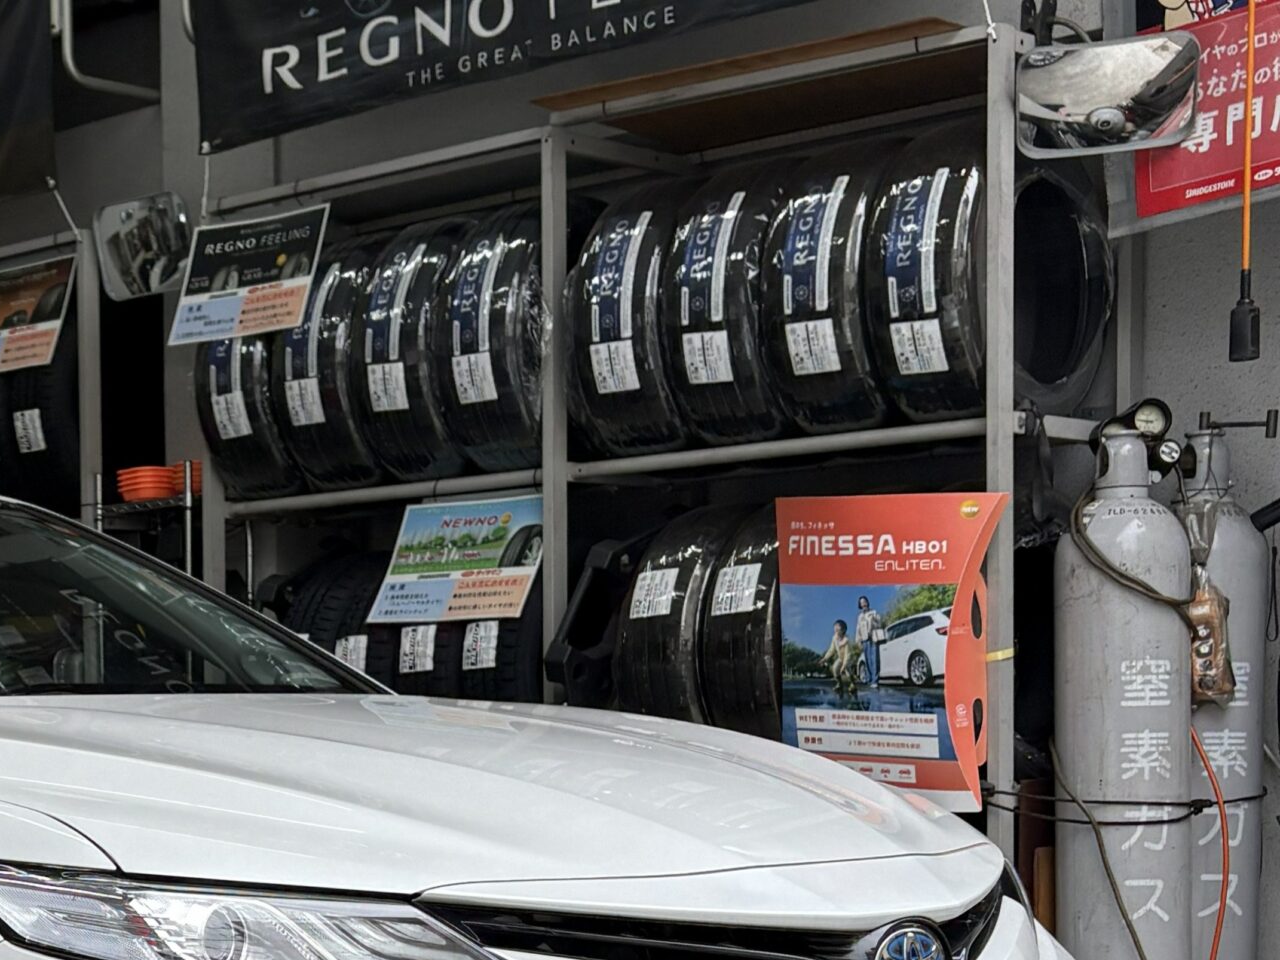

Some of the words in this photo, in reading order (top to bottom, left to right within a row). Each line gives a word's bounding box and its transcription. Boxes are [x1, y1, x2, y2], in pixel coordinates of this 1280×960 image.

[261, 0, 515, 94] REGNO
[406, 62, 445, 88] THE
[551, 6, 676, 51] BALANCE
[1186, 178, 1235, 199] BRIDGESTONE
[204, 238, 256, 255] REGNO
[260, 226, 311, 245] FEELING
[441, 515, 499, 528] NEWNO
[788, 534, 896, 556] FINESSA
[902, 540, 948, 554] HB01
[1120, 654, 1171, 922] 窒素ガス
